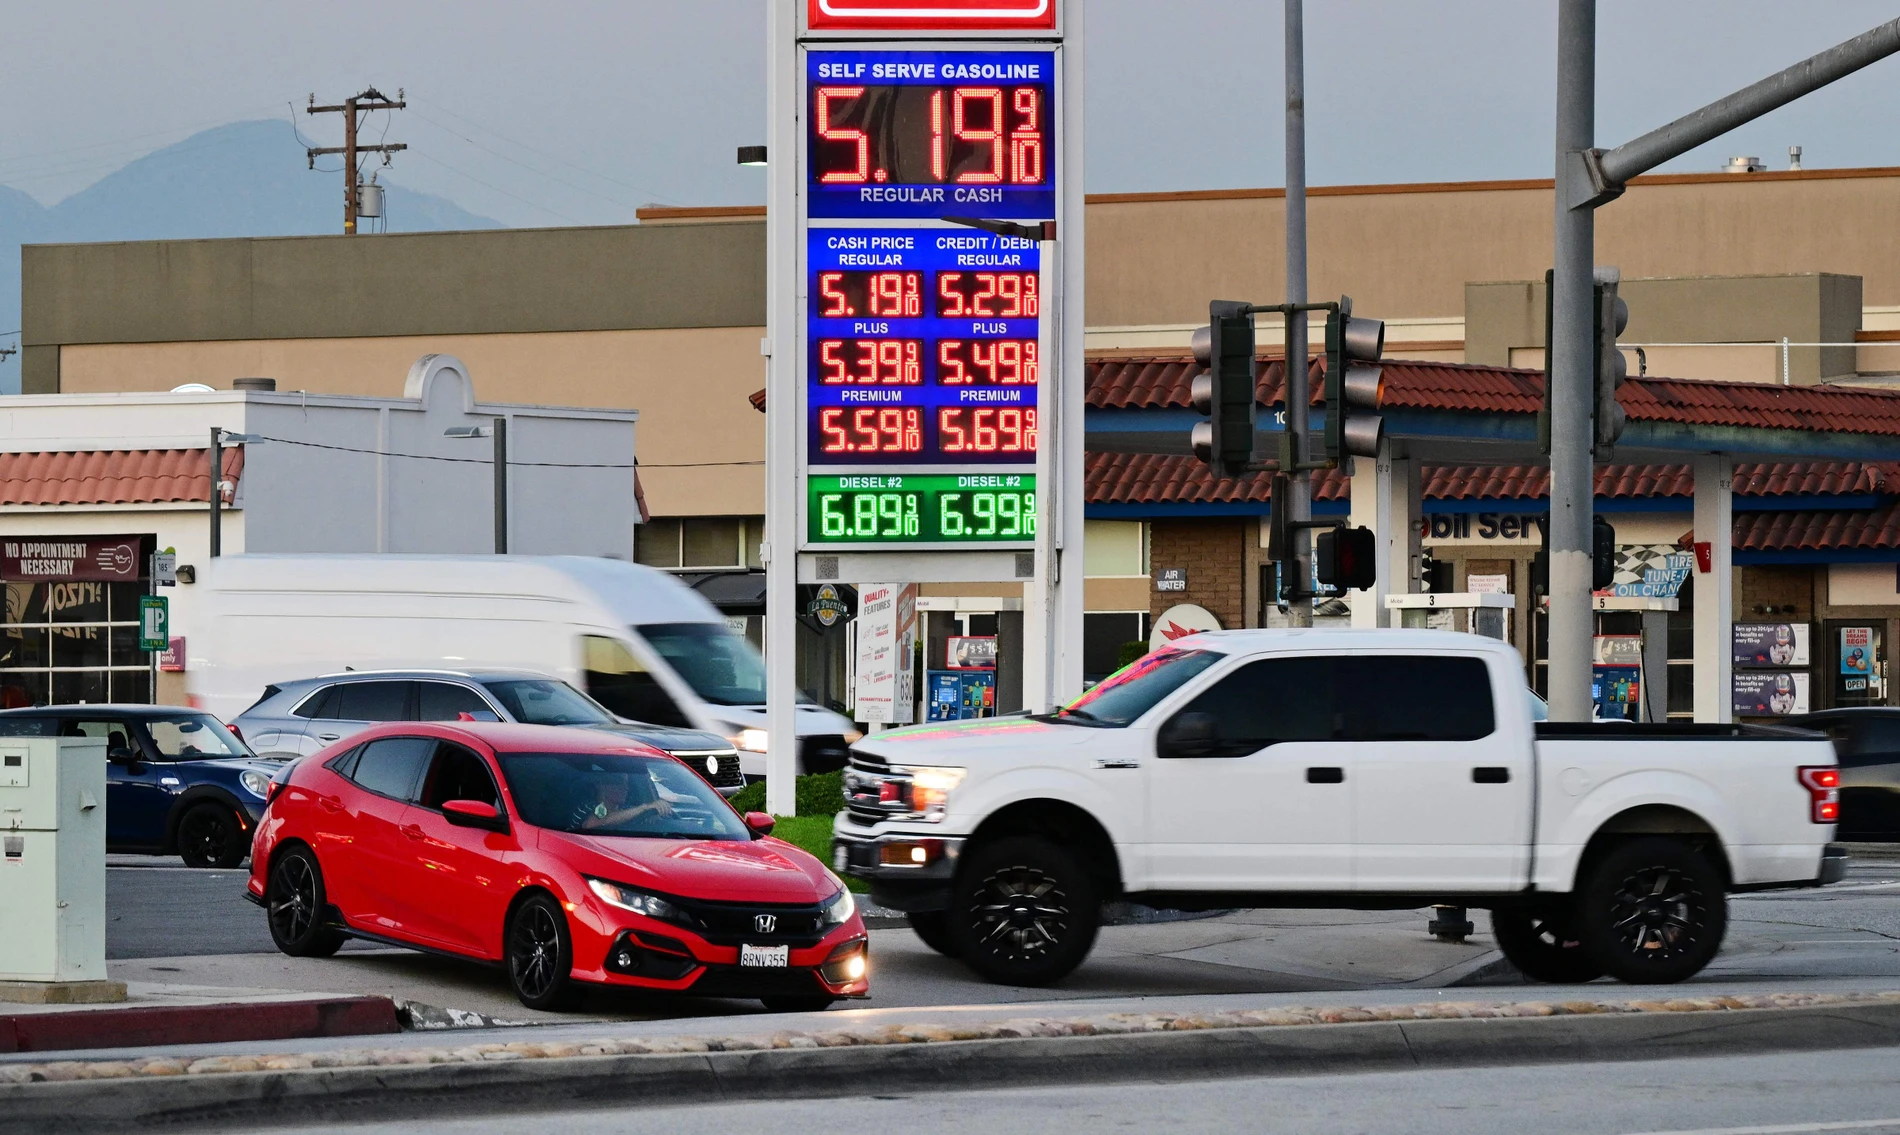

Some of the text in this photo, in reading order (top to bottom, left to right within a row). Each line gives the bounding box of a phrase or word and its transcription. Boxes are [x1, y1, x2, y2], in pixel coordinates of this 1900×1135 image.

[818, 63, 1040, 78] SELF SERVE GASOLINE
[817, 87, 1003, 182] 5.19
[860, 188, 1002, 202] REGULAR CASH
[827, 237, 914, 250] CASH PRICE
[936, 237, 989, 250] CREDIT
[839, 254, 902, 266] REGULAR
[958, 254, 1021, 266] REGULAR
[822, 274, 902, 316] 5.19
[940, 274, 1020, 316] 5.29
[854, 322, 889, 334] PLUS
[972, 322, 1007, 334] PLUS
[822, 342, 902, 383] 5.39
[940, 342, 1020, 383] 5.49
[841, 390, 902, 402] PREMIUM
[960, 390, 1020, 402] PREMIUM
[822, 409, 902, 451] 5.59
[941, 409, 1020, 451] 5.69
[839, 477, 902, 488] DIESEL #2
[958, 476, 1020, 487] DIESEL #2
[822, 494, 902, 536] 6.89
[940, 493, 1020, 536] 6.99
[5, 543, 87, 558] NO APPOINTMENT
[20, 560, 74, 575] NECESSARY
[158, 563, 168, 572] 185
[1669, 556, 1692, 568] TIRE
[1164, 570, 1178, 579] AIR
[1157, 580, 1185, 590] WATER
[1618, 585, 1638, 596] OIL
[1430, 595, 1434, 606] 3
[1600, 598, 1605, 608] 5
[864, 599, 891, 616] FEATURES
[161, 655, 176, 663] only
[742, 953, 785, 967] 8RNV355
